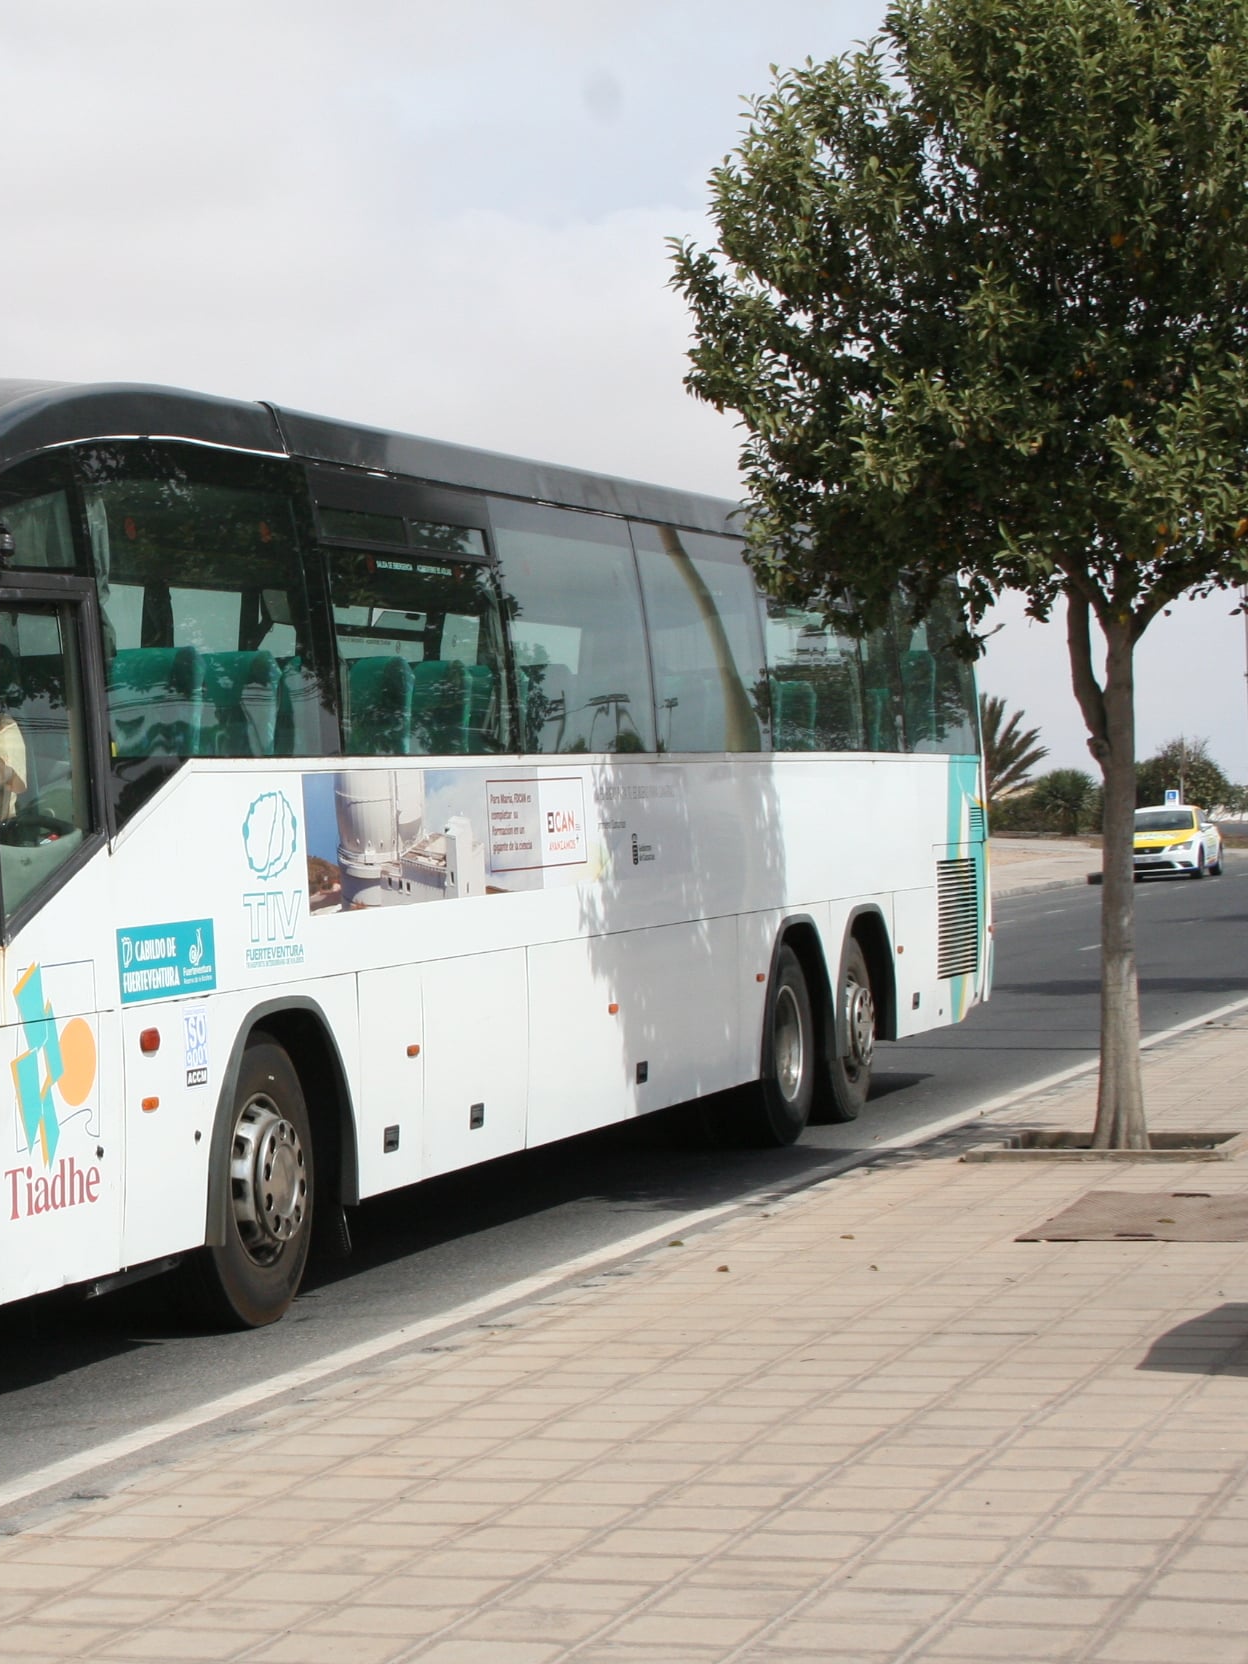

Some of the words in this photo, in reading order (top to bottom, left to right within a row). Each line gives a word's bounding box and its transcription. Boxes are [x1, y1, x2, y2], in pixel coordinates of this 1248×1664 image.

[243, 890, 302, 943] TIV
[135, 937, 166, 962] CABILDO
[166, 936, 177, 958] DE
[246, 944, 305, 961] FUERTEVENTURA
[123, 965, 181, 994] FUERTEVENTURA
[184, 1014, 207, 1051] ISO
[187, 1069, 207, 1086] ACCM
[4, 1156, 100, 1220] Tiadhe
